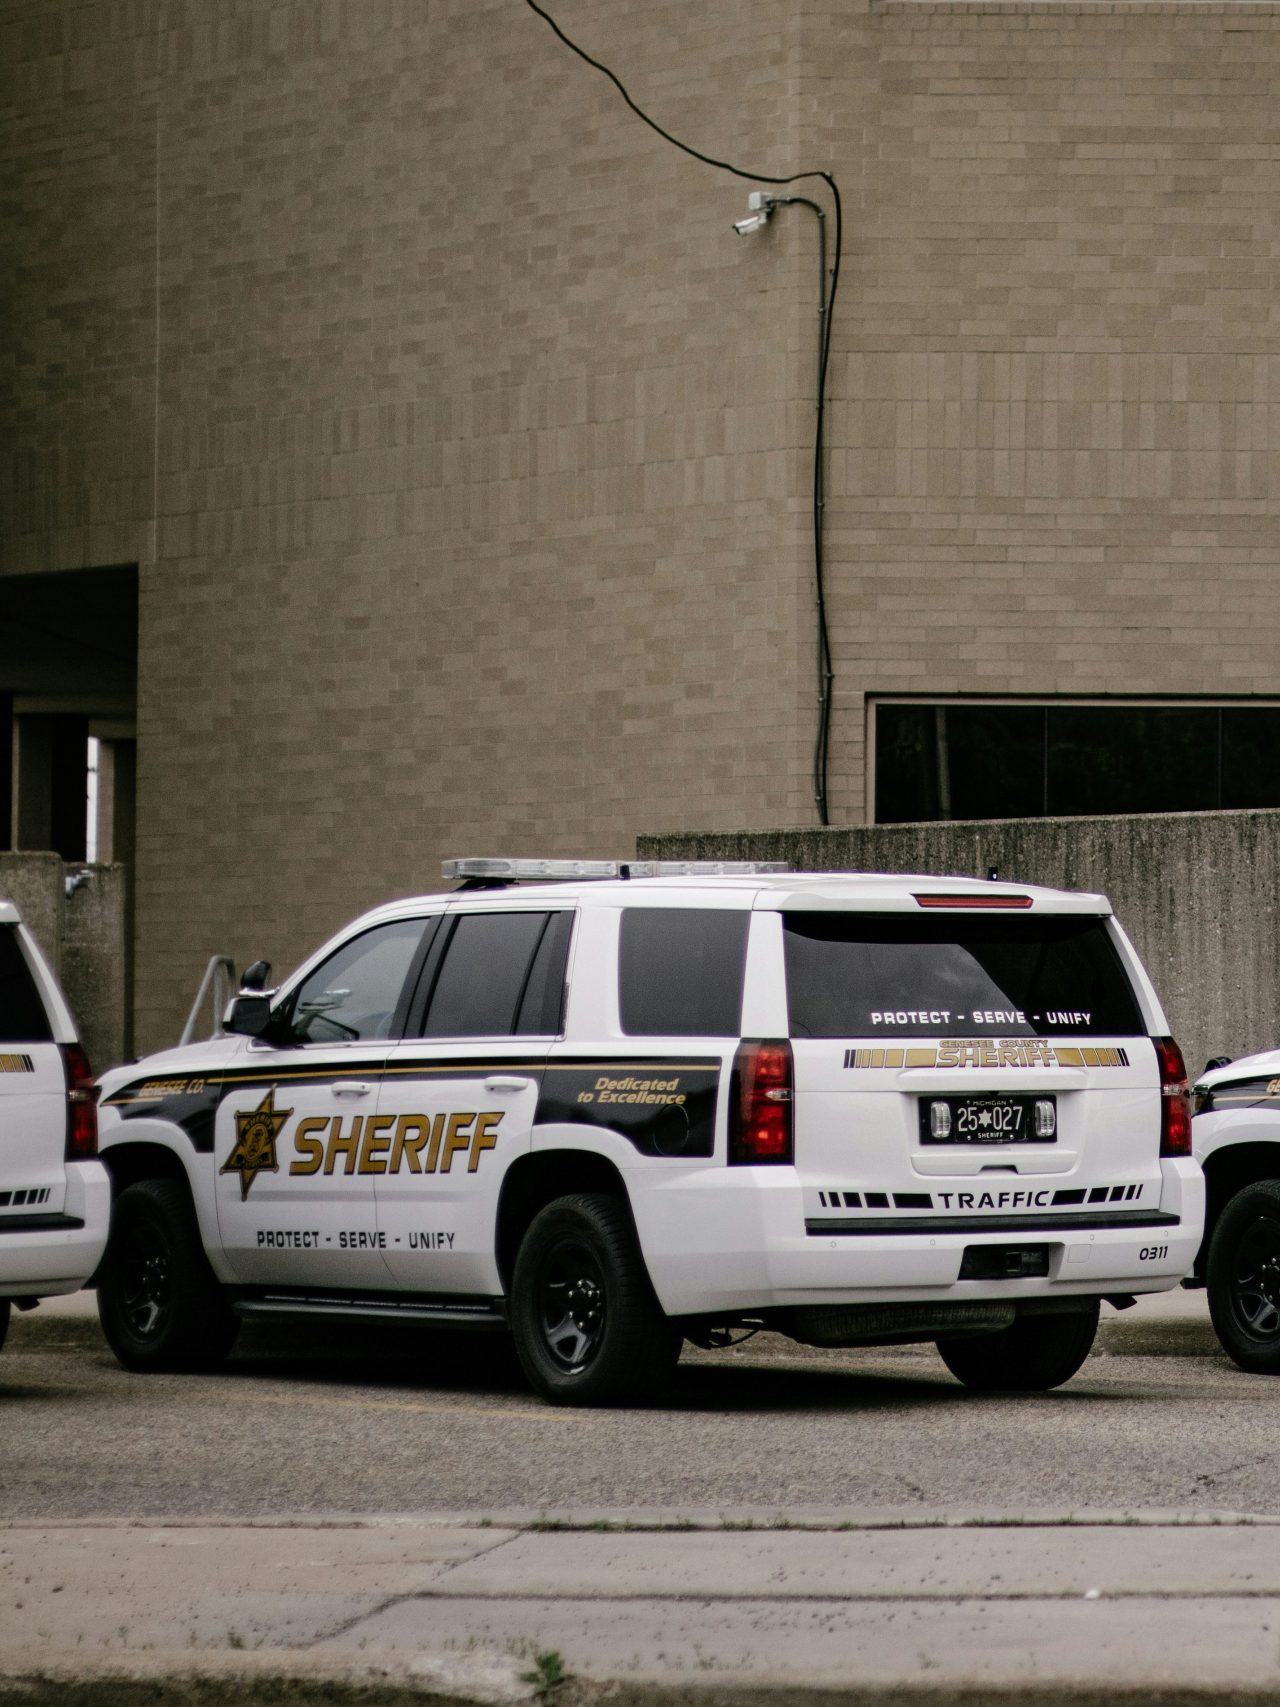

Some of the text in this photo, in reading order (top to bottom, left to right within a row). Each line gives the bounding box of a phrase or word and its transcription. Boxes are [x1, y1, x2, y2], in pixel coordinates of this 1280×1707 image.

[871, 1011, 950, 1025] PROTECT
[972, 1011, 1026, 1024] SERVE
[1046, 1011, 1092, 1025] UNIFY
[939, 1039, 1049, 1049] GENESEE COUNTY
[936, 1048, 1056, 1068] SHERIFF
[186, 1078, 205, 1095] CO.
[595, 1078, 680, 1091] Dedicated
[577, 1091, 687, 1104] to Excellence
[957, 1106, 1023, 1131] 25 027
[289, 1111, 506, 1176] SHERIFF
[937, 1191, 1050, 1209] TRAFFIC
[257, 1230, 319, 1248] PROTECT
[339, 1231, 387, 1249] SERVE
[409, 1232, 455, 1249] UNIFY
[1139, 1245, 1168, 1261] 0311
